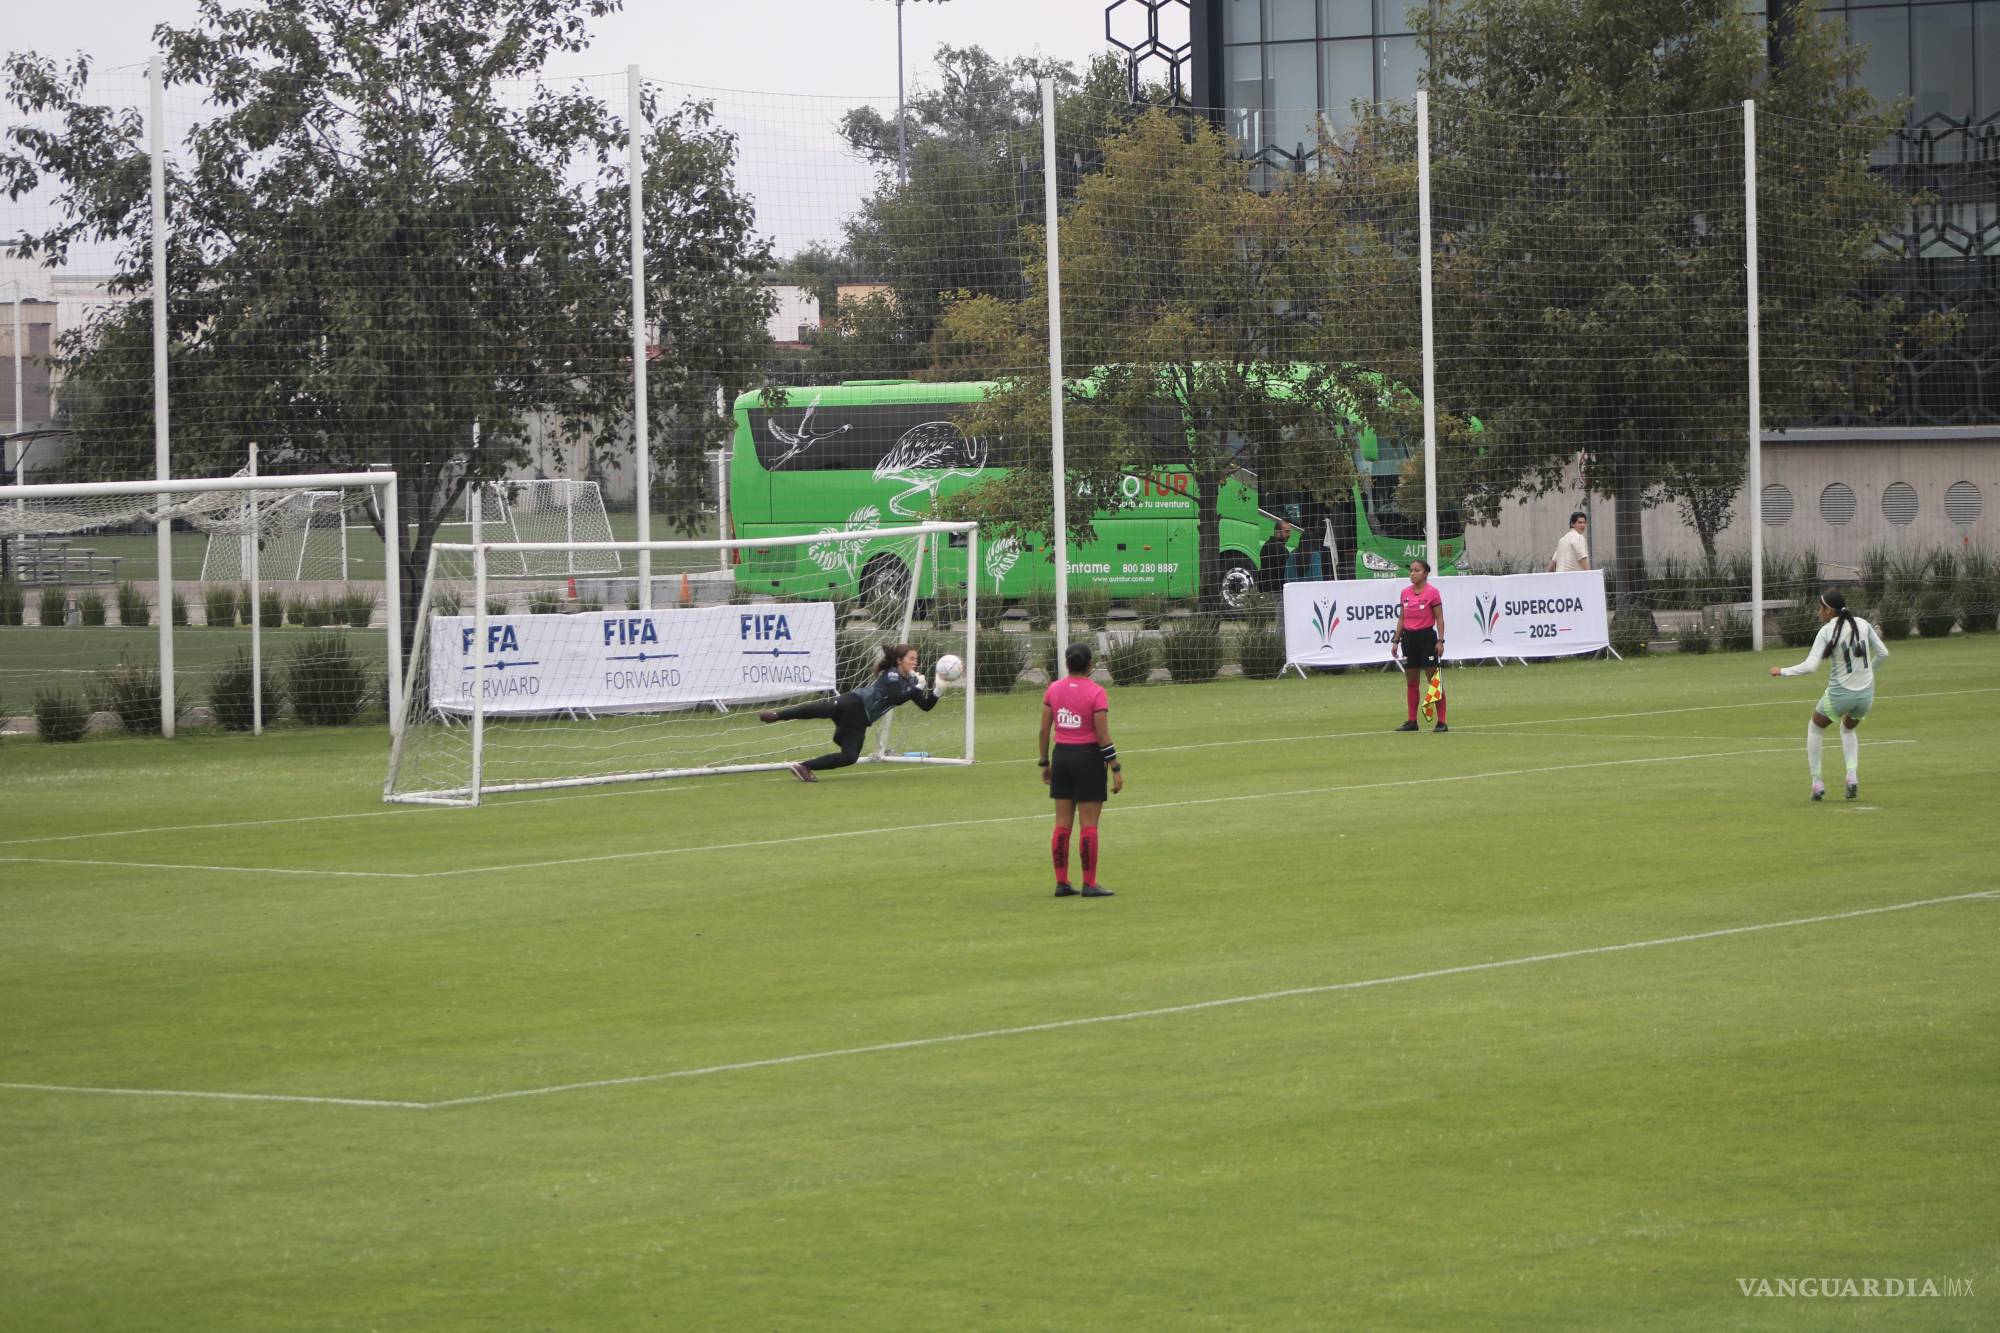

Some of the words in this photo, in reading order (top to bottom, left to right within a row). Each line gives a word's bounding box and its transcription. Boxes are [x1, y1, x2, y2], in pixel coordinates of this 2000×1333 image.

[1403, 544, 1453, 557] AUTUR
[1066, 561, 1111, 574] éntame
[1122, 563, 1138, 573] 800
[1140, 563, 1156, 573] 280
[1157, 563, 1178, 573] 8887
[1092, 575, 1155, 583] www.autotur.com.mx
[1505, 596, 1584, 617] SUPERCOPA
[603, 617, 659, 646] FIFA
[740, 613, 792, 641] FIFA
[1374, 630, 1397, 644] 202
[1529, 623, 1558, 639] 2025
[462, 624, 519, 656] FFA
[1842, 640, 1868, 673] 14
[605, 667, 681, 690] FORWARD
[742, 664, 812, 684] FORWARD
